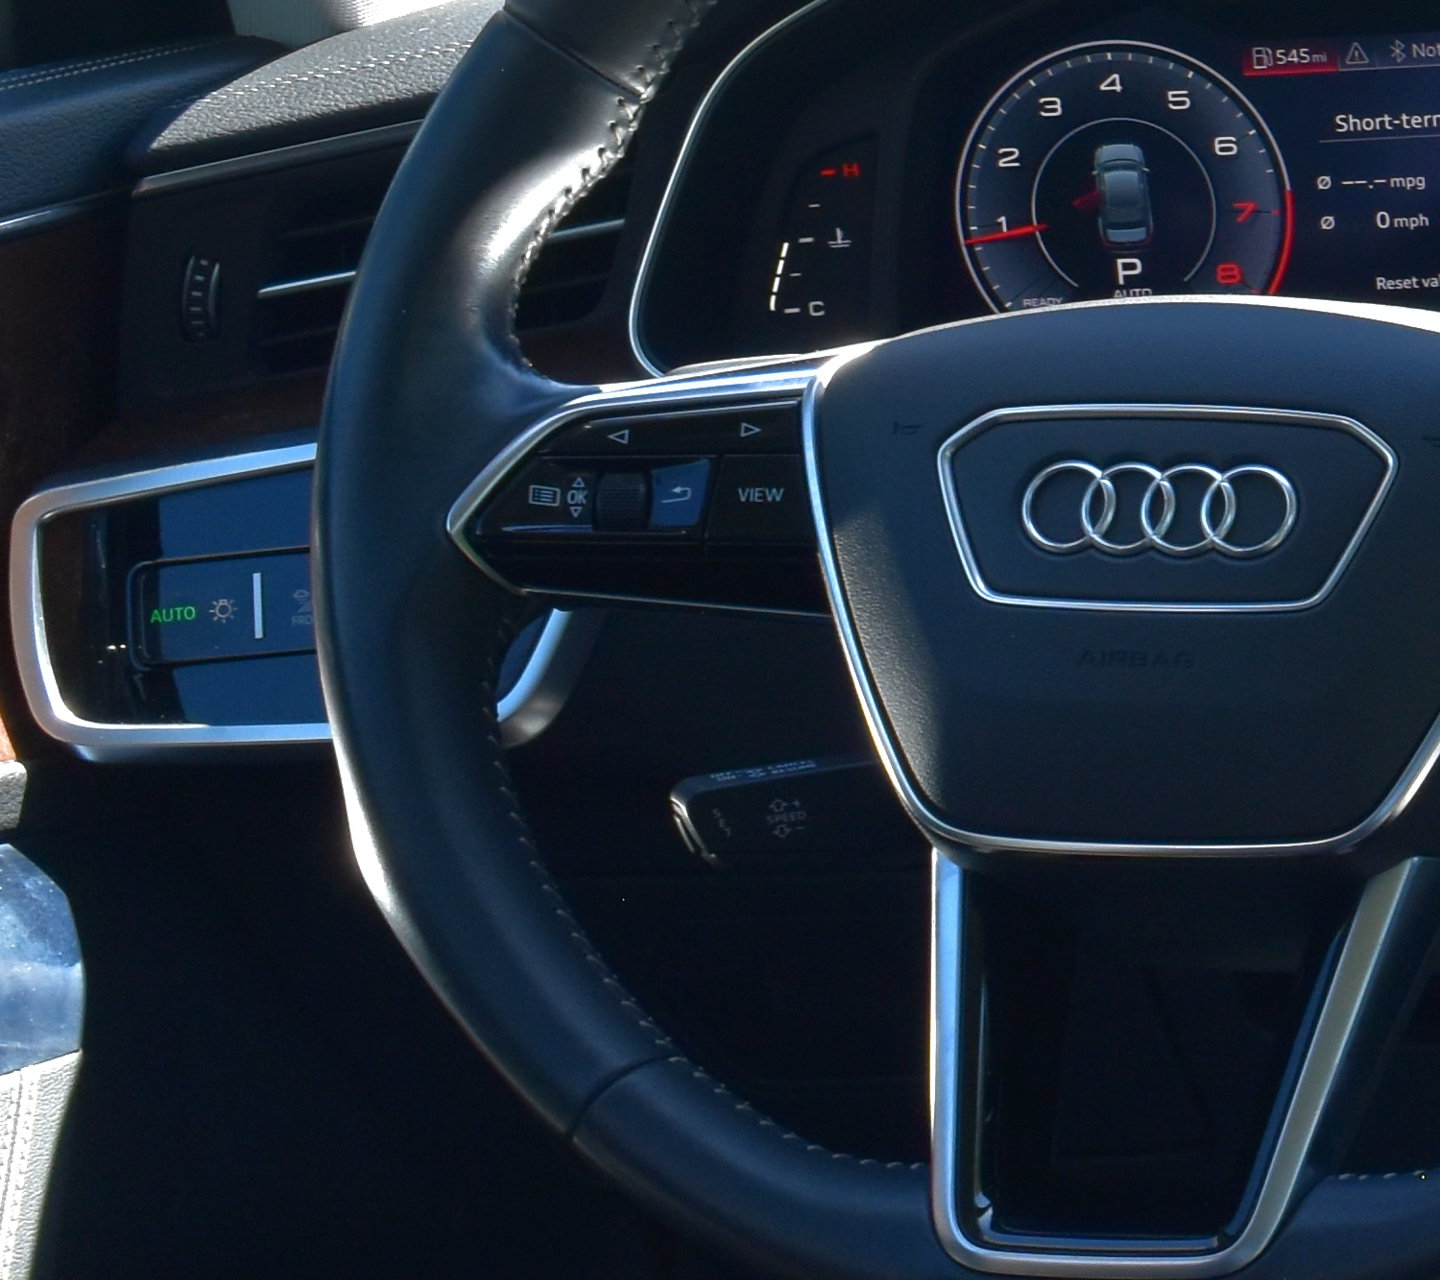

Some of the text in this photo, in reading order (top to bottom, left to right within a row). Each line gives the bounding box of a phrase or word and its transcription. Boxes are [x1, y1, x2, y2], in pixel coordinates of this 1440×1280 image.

[1275, 48, 1329, 65] 545 mi
[1412, 42, 1440, 58] Not
[1100, 73, 1124, 94] 4
[1038, 97, 1063, 118] 3
[1167, 90, 1191, 111] 5
[1214, 136, 1238, 157] 6
[998, 148, 1020, 169] 2
[1390, 174, 1426, 191] mpg
[1233, 202, 1257, 223] 7
[1376, 210, 1430, 230] 0 mph
[1116, 257, 1143, 286] P
[1215, 262, 1242, 285] 8
[1376, 274, 1421, 290] Reset
[809, 300, 826, 318] C
[566, 488, 588, 507] OK
[738, 487, 784, 504] VIEW
[149, 604, 197, 624] AUTO
